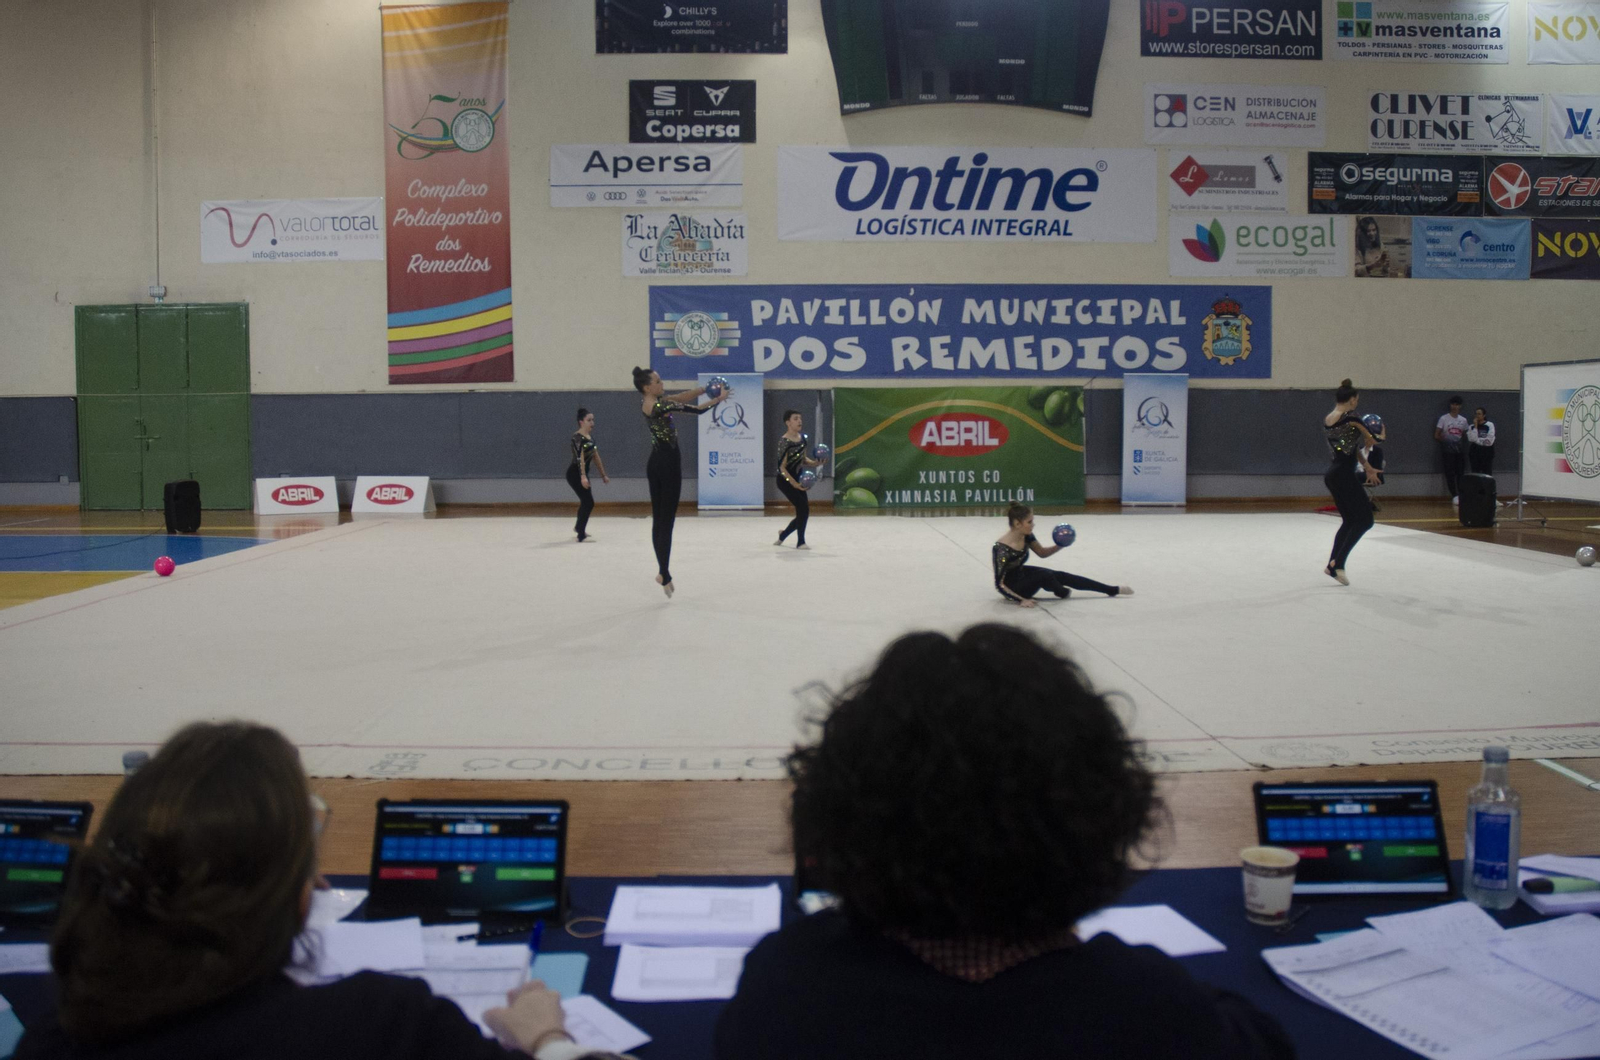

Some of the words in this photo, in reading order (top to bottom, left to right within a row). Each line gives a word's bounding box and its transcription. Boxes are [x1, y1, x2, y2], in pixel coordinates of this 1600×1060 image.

[679, 6, 717, 15] CHILLY'S
[1376, 11, 1490, 22] www.masventana.es
[653, 19, 677, 28] Explore
[695, 19, 711, 27] 1000
[1192, 8, 1316, 36] PERSAN
[1374, 22, 1501, 39] masventana
[1149, 41, 1315, 57] www.storespersan.com
[1434, 52, 1489, 60] MOTORIZACIÓN
[843, 102, 870, 110] MONDO
[1062, 103, 1089, 112] MONDO
[1246, 97, 1317, 108] DISTRIBUCIÓN
[1370, 92, 1475, 115] CLIVET
[693, 109, 740, 117] CUPRA
[1246, 110, 1317, 121] ALMACENAJE
[646, 119, 740, 142] Copersa
[1370, 118, 1475, 141] OURENSE
[583, 150, 711, 178] Apersa
[828, 152, 1100, 213] Ontime
[1362, 167, 1453, 185] segurma
[407, 179, 489, 202] Complexo
[1391, 193, 1412, 201] Hogar
[1419, 194, 1448, 202] Negocio
[1538, 199, 1581, 207] ESTACIONES
[1581, 199, 1591, 207] DE
[393, 207, 503, 231] Polideportivo
[624, 213, 658, 240] La
[856, 215, 966, 236] LOGÍSTICA
[971, 218, 1073, 237] INTEGRAL
[435, 234, 462, 251] dos
[1236, 217, 1336, 257] ecogal
[252, 249, 339, 260] info@vtasociados.es
[1483, 243, 1515, 252] centro
[406, 253, 492, 274] Remedios
[750, 287, 943, 326] PAVILLÓN
[961, 298, 1187, 326] MUNICIPAL
[752, 335, 867, 372] DOS
[891, 335, 1188, 372] REMEDIOS
[920, 421, 999, 446] ABRIL
[919, 470, 975, 484] XUNTOS
[983, 470, 1000, 483] CO
[278, 487, 320, 501] ABRIL
[370, 487, 409, 500] ABRIL
[885, 489, 957, 503] XIMNASIA
[965, 486, 1035, 502] PAVILLÓN
